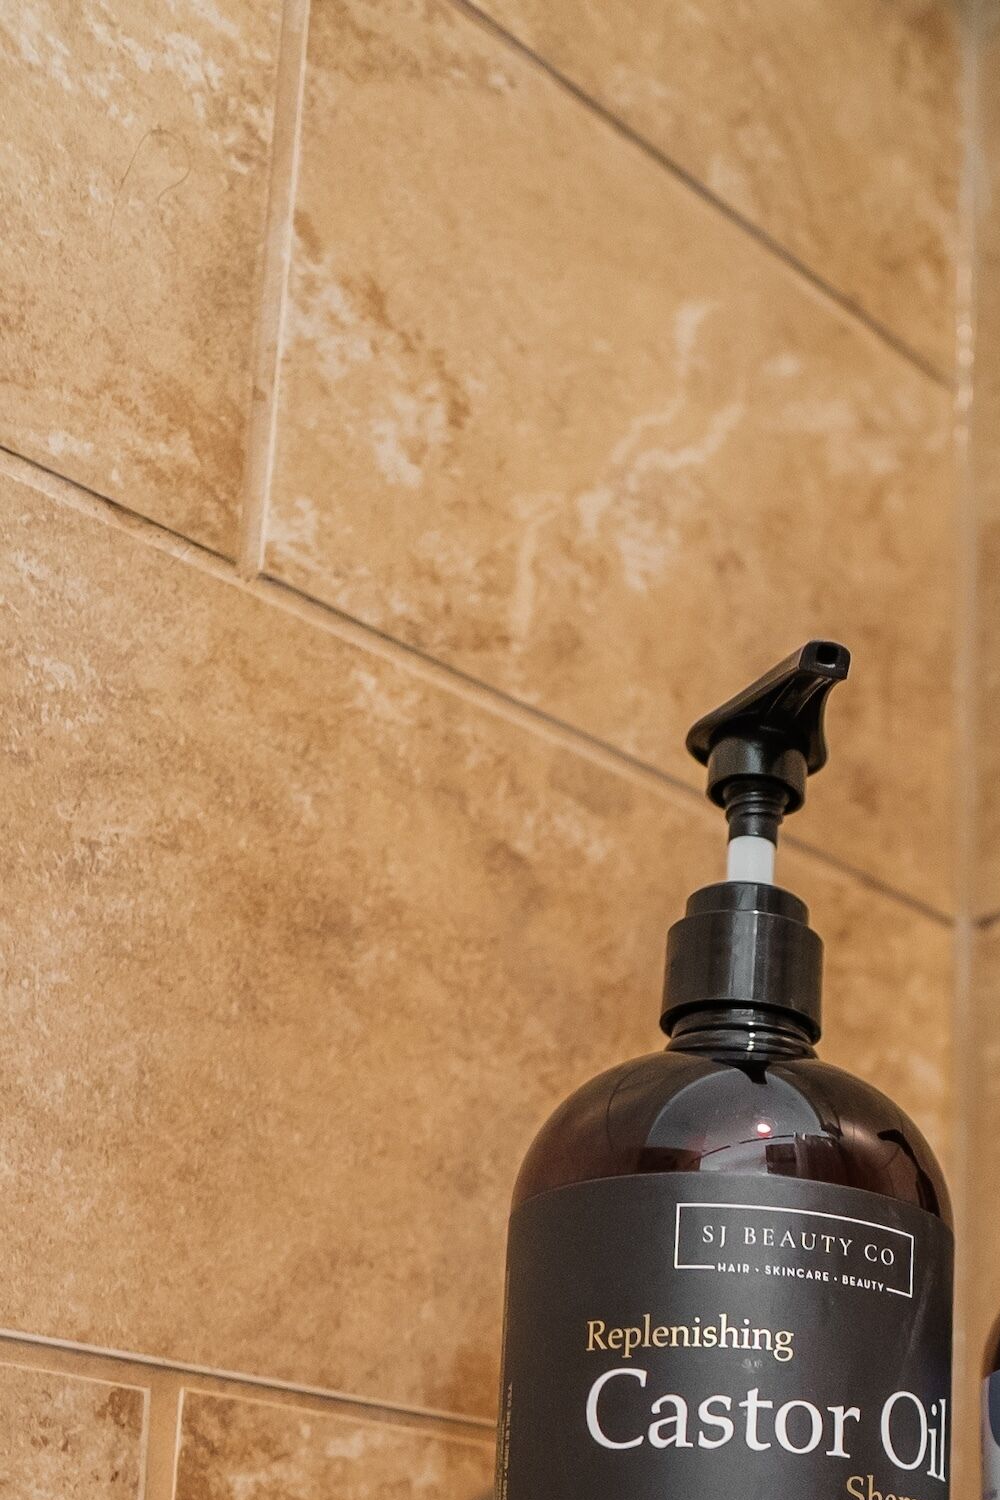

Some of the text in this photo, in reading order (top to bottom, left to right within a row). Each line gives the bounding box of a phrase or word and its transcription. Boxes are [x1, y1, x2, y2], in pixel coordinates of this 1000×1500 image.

[702, 1225, 894, 1265] SJ BEAUTY CO
[717, 1262, 884, 1292] HAIR SKINCARE BEAUTY
[586, 1314, 794, 1362] Replenishing
[585, 1367, 861, 1458] Castor
[880, 1391, 946, 1482] Oil
